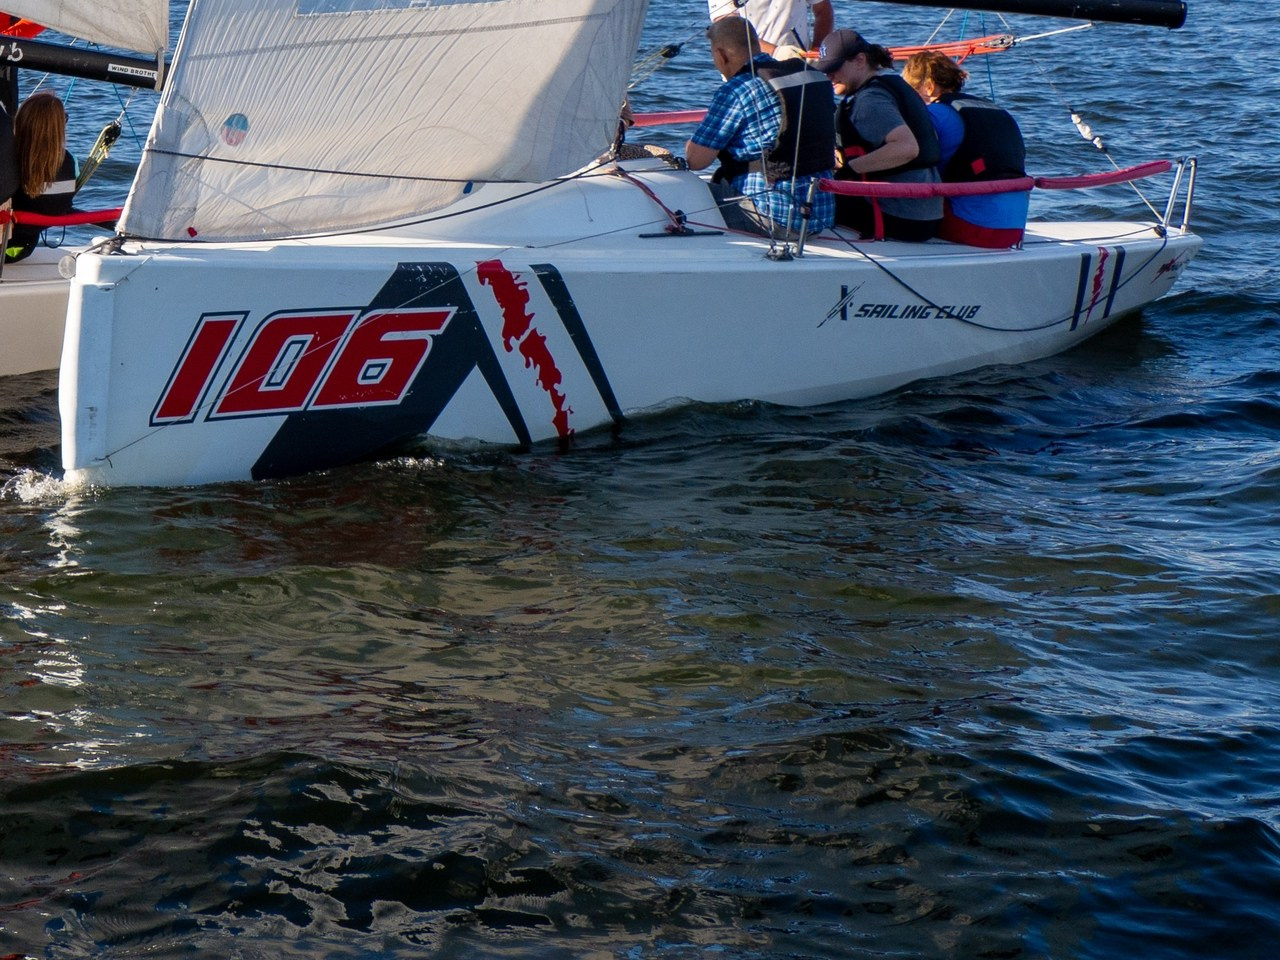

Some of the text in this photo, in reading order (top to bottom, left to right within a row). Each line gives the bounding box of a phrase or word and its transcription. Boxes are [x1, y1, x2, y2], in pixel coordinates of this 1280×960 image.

[111, 65, 129, 73] WIND
[854, 303, 937, 319] SAILING
[934, 305, 981, 319] CLUB
[149, 305, 458, 426] 106
